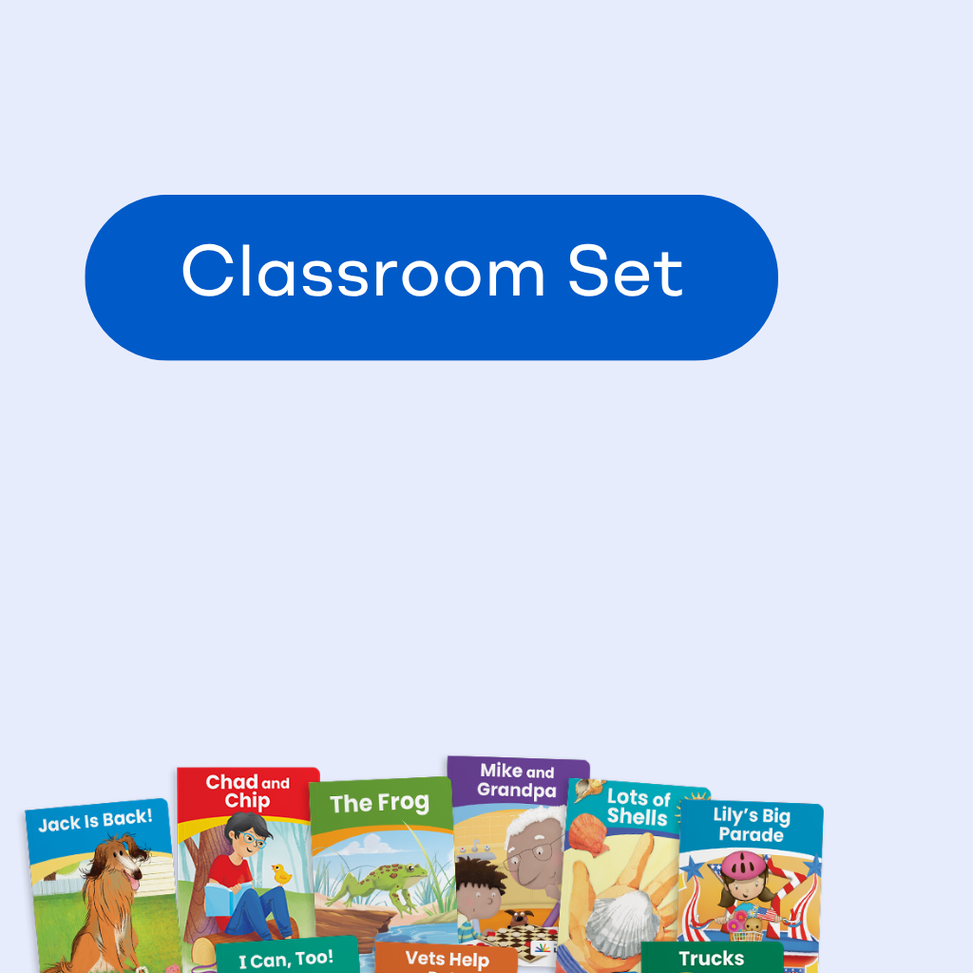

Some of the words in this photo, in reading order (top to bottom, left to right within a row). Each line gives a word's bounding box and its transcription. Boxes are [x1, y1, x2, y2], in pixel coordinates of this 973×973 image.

[480, 761, 523, 778] Mike
[526, 766, 555, 779] and
[206, 773, 258, 790] Chad
[261, 777, 290, 789] and
[225, 791, 271, 813] Chip
[477, 782, 557, 802] Grandpa
[607, 788, 648, 806] Lots
[652, 792, 671, 807] of
[329, 794, 373, 813] The
[378, 793, 430, 816] Frog
[38, 815, 81, 833] Jack
[84, 814, 99, 829] Is
[103, 808, 153, 827] Back!
[607, 807, 668, 827] Shells
[762, 807, 791, 828] Big
[719, 826, 784, 843] Parade
[239, 955, 247, 970] I
[250, 954, 291, 969] Can,
[295, 949, 333, 965] Too!
[405, 950, 445, 966] Vets
[449, 952, 490, 972] Help
[678, 950, 744, 966] Trucks
